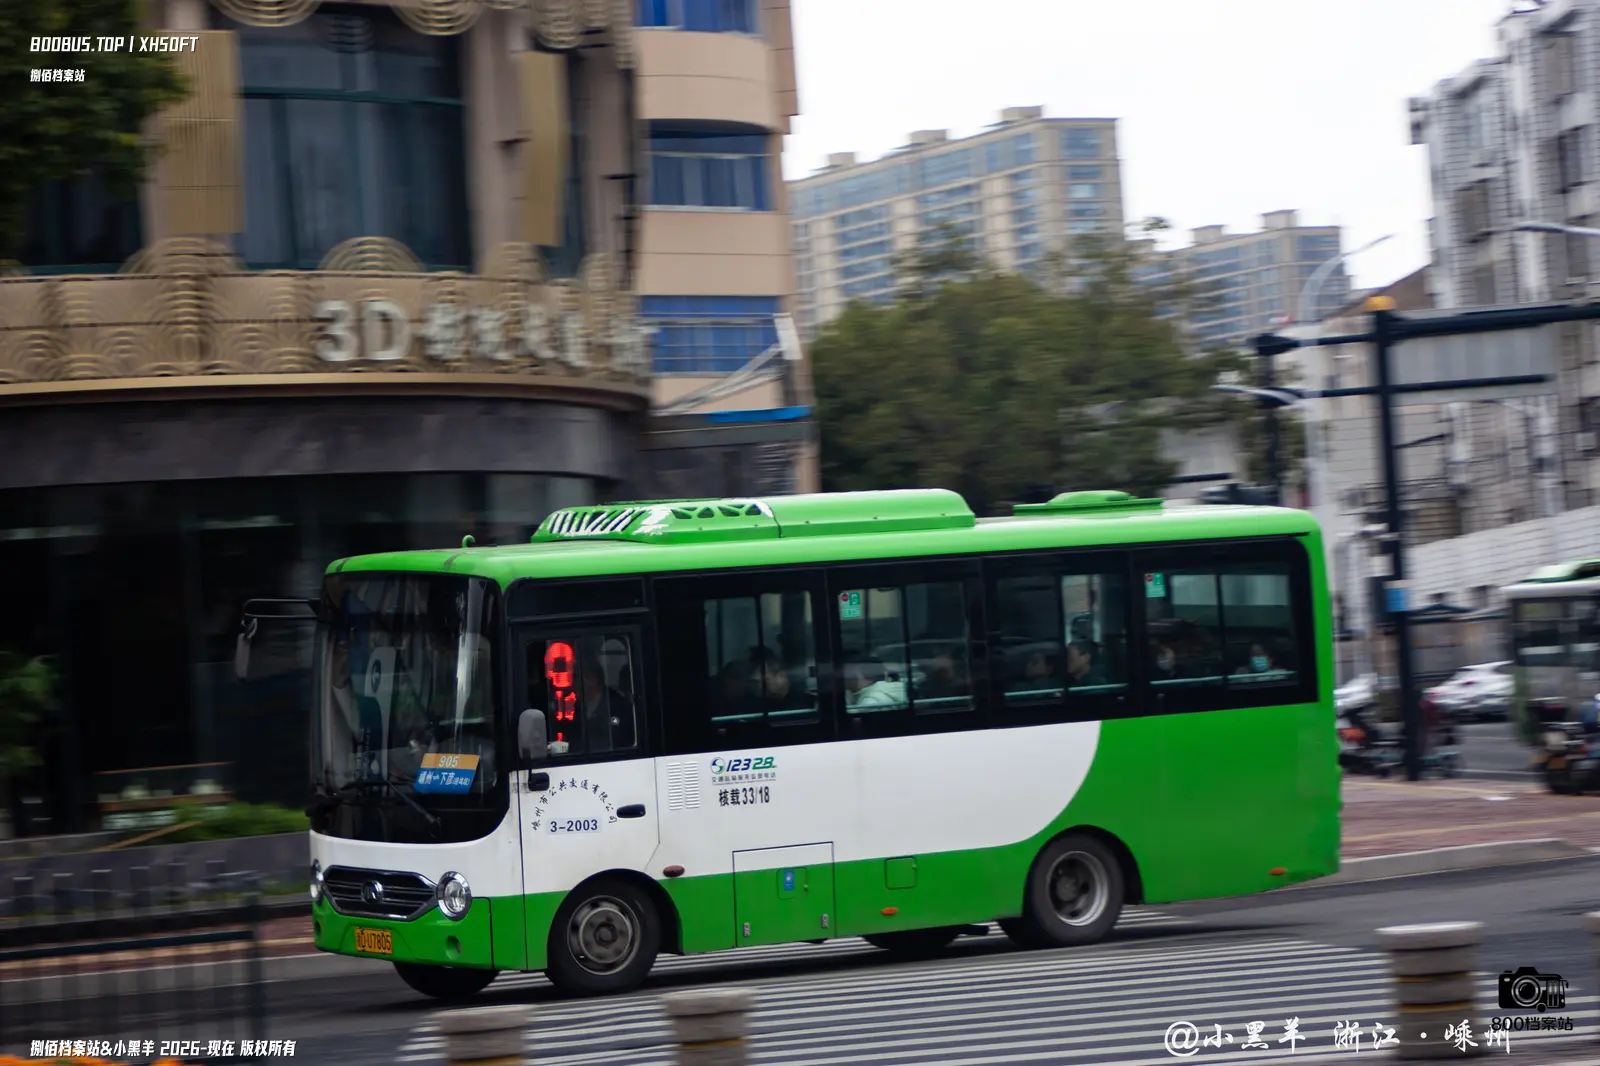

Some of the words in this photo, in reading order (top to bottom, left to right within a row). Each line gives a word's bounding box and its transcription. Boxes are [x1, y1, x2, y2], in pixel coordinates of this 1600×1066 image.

[314, 301, 410, 362] 3D
[439, 755, 460, 768] 905
[726, 756, 774, 772] 12328
[550, 819, 598, 833] 3-2003
